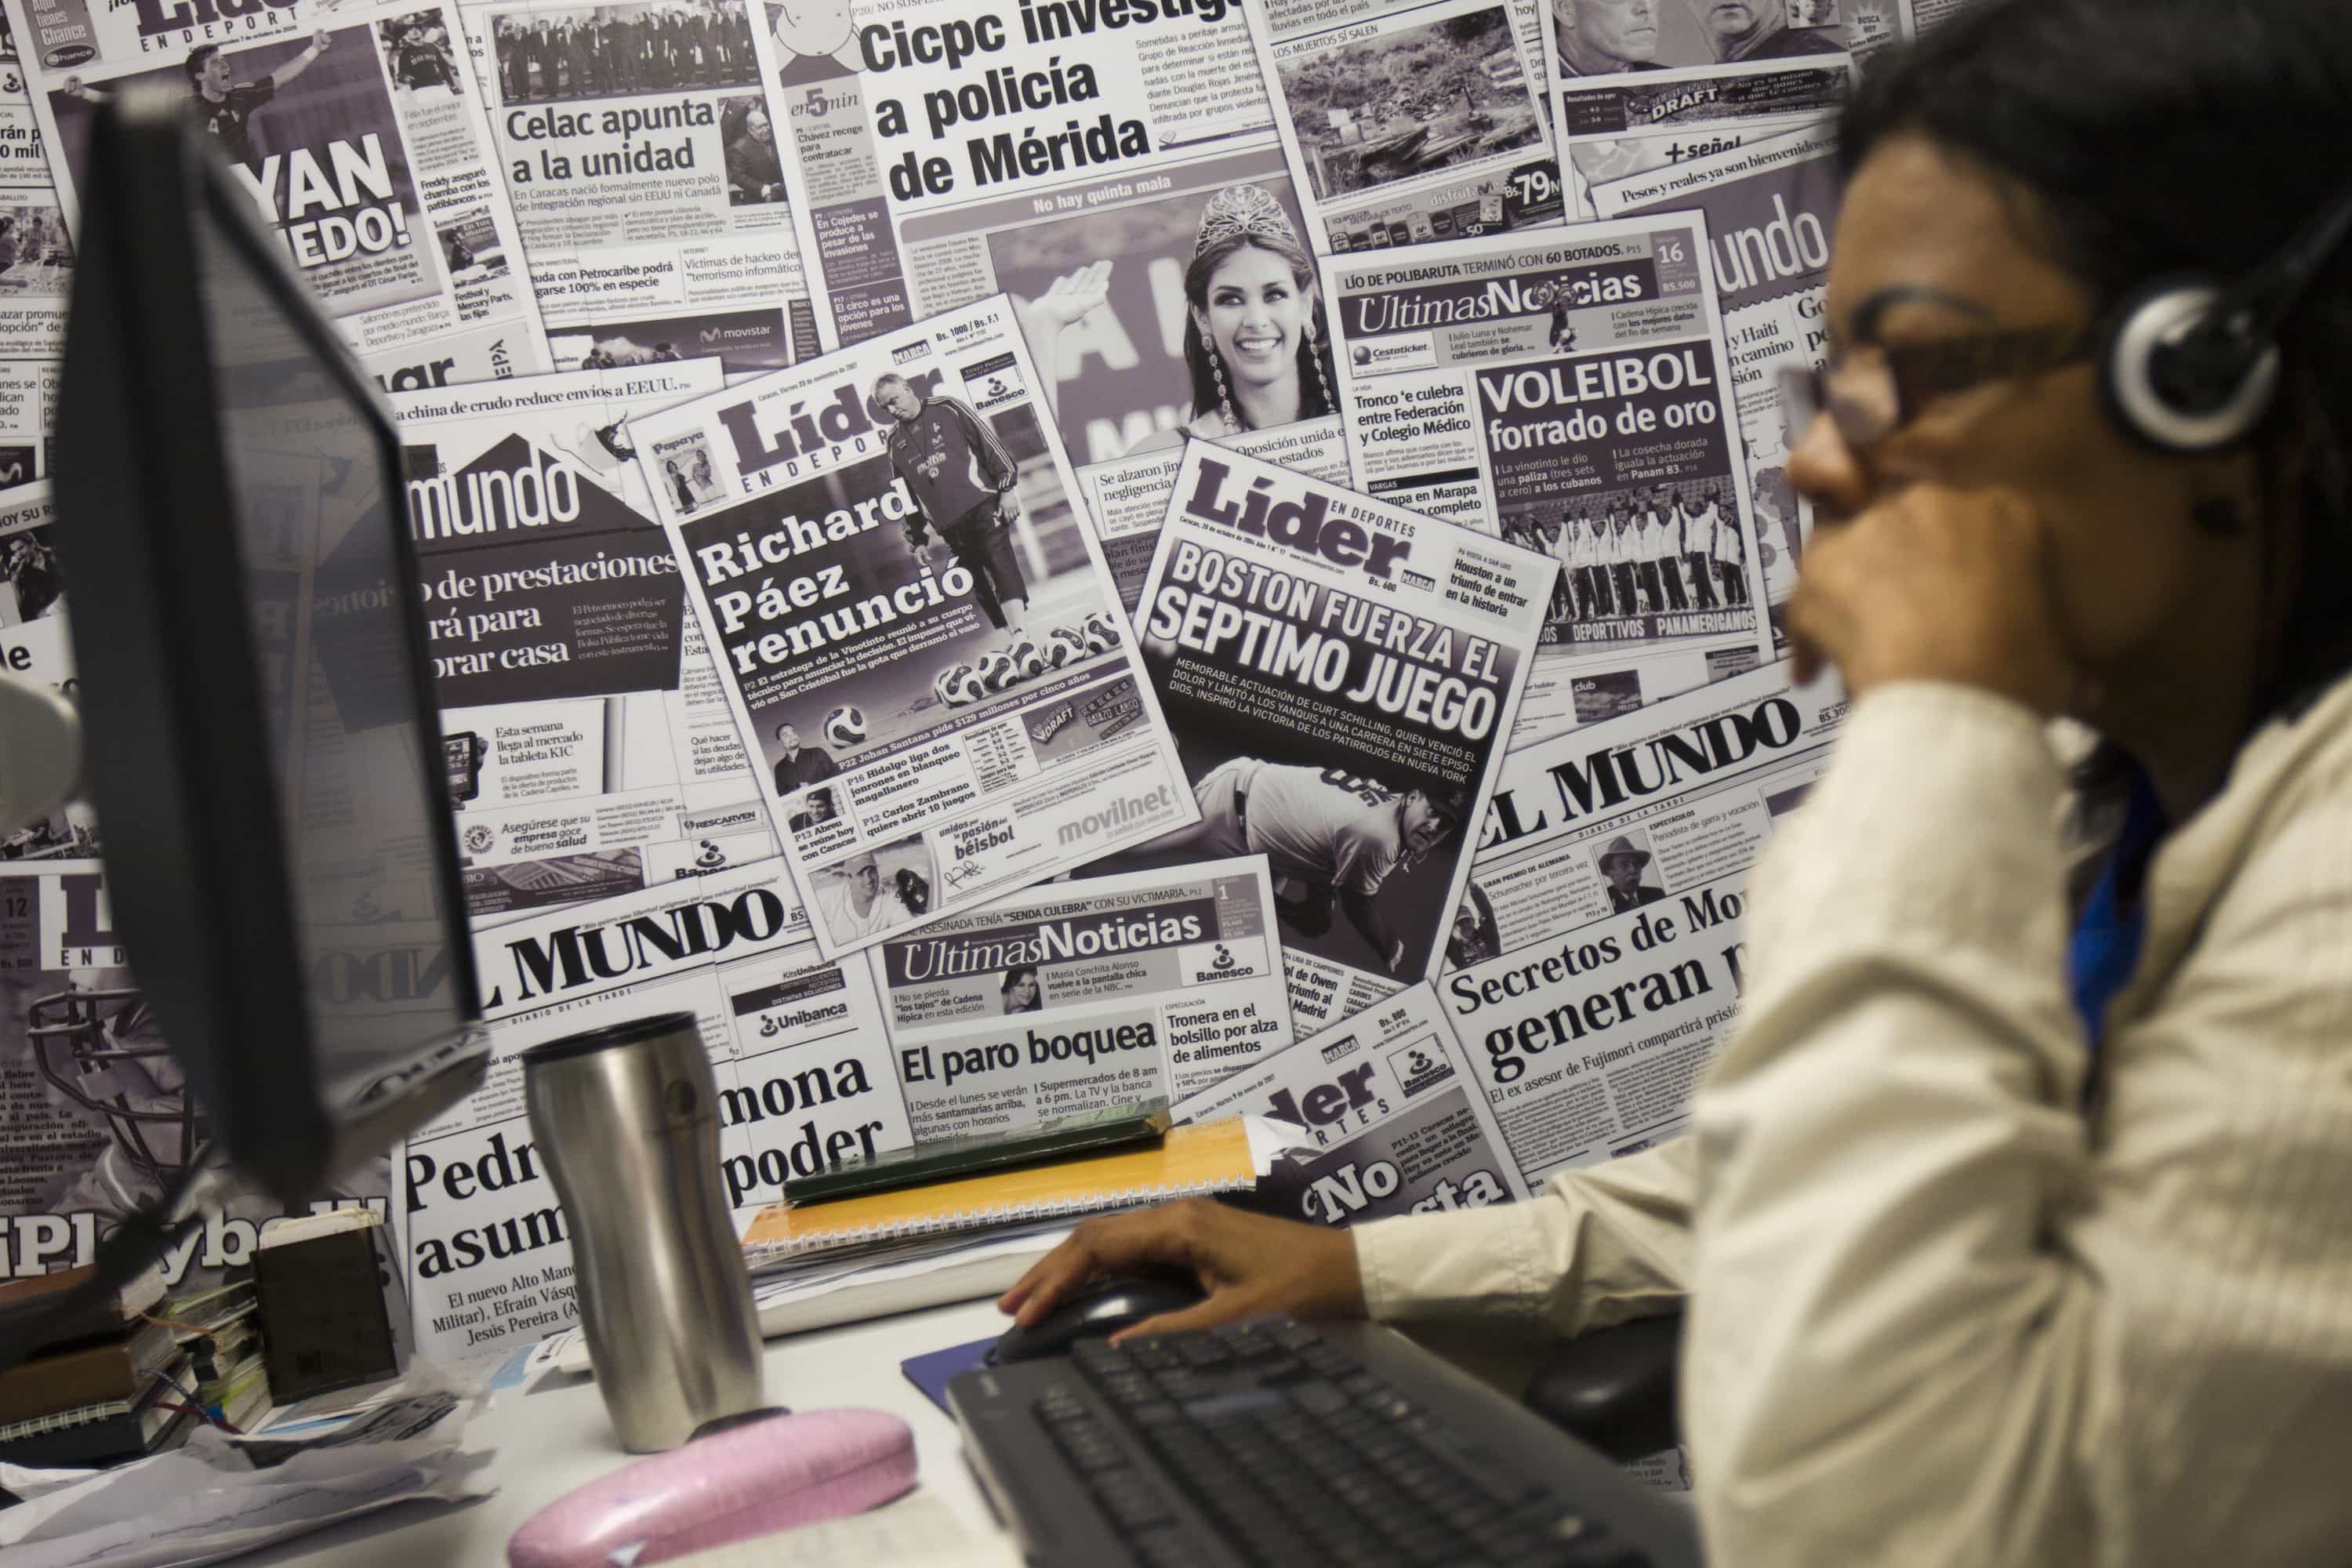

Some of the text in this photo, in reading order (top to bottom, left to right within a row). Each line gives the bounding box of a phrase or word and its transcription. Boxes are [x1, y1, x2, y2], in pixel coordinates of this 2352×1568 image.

[862, 13, 1006, 73] Cicpc
[1273, 46, 1291, 58] LOS
[1294, 35, 1337, 52] MUERTOS
[1349, 25, 1378, 39] SALEN
[875, 56, 1100, 138] a policía
[506, 99, 715, 142] Celac apunta
[512, 138, 696, 184] a la unidad
[888, 151, 953, 201] de
[967, 112, 1151, 187] Mérida
[1621, 136, 1826, 203] Pesos y reales ya son bienvenidos
[1033, 175, 1172, 214] No hay quinta mala
[1345, 277, 1365, 290] LÍO
[1367, 274, 1384, 287] DE
[1386, 265, 1461, 285] POLIBARUTA
[1462, 256, 1515, 276] TERMINÓ
[1518, 254, 1543, 267] CON
[1545, 251, 1562, 264] 60
[1564, 244, 1624, 262] BOTADOS.
[1657, 243, 1684, 263] 16
[724, 325, 771, 339] movistar
[1731, 320, 1779, 350] y Haití
[408, 378, 678, 419] china de crudo reduce envíos a EEUU.
[975, 389, 1025, 410] Banesco
[1355, 391, 1399, 411] Tronco
[1416, 384, 1464, 401] culebra
[1480, 349, 1711, 414] VOLEIBOL
[1358, 401, 1465, 426] entre Federación
[1360, 418, 1471, 445] y Colegio Médico
[1490, 398, 1717, 452] forrado de oro
[408, 440, 581, 540] mundo
[696, 477, 920, 587] Richard
[1186, 458, 1411, 579] Líder
[1330, 500, 1416, 537] EN DEPORTES
[437, 552, 679, 601] de prestaciones
[1450, 573, 1527, 607] triunfo de entrar
[1454, 558, 1516, 588] Houston a un
[713, 564, 851, 634] Páez
[731, 557, 975, 677] renunció
[1171, 539, 1500, 684] BOSTON FUERZA EL
[1446, 590, 1508, 617] en la historia
[469, 608, 542, 642] para
[1573, 610, 1756, 641] DEPORTIVOS PANAMERICANOS
[501, 642, 571, 669] casa
[1177, 658, 1476, 763] MEMORABLE ACTUACIÓN DE CURT SCHILLING, QUIEN VENCIÓ EL
[1346, 653, 1495, 741] JUEGO
[495, 721, 564, 739] Esta semana
[496, 731, 583, 752] llega al mercado
[839, 672, 1091, 771] P22 Johan Santana pide $129 millones por cinco años
[499, 746, 573, 765] la tableta KIC
[1547, 697, 1802, 822] MUNDO
[1058, 784, 1170, 847] movilnet
[954, 826, 1014, 861] béisbol
[1094, 899, 1114, 909] CON
[1116, 896, 1131, 908] SU
[1132, 888, 1188, 905] VICTIMARIA.
[505, 889, 783, 1000] MUNDO
[1450, 935, 1622, 1016] Secretos
[1631, 913, 1677, 952] de
[1196, 966, 1254, 984] Banesco
[777, 1003, 848, 1029] Unibanca
[1167, 1004, 1257, 1029] Tronera en el
[1170, 1020, 1279, 1047] bolsillo por alza
[1485, 956, 1713, 1083] generan
[902, 1022, 1157, 1087] El paro boquea
[1173, 1041, 1261, 1063] de alimentos
[1490, 1018, 1704, 1105] El ex asesor de Fujimori compartirá
[721, 1120, 883, 1208] poder
